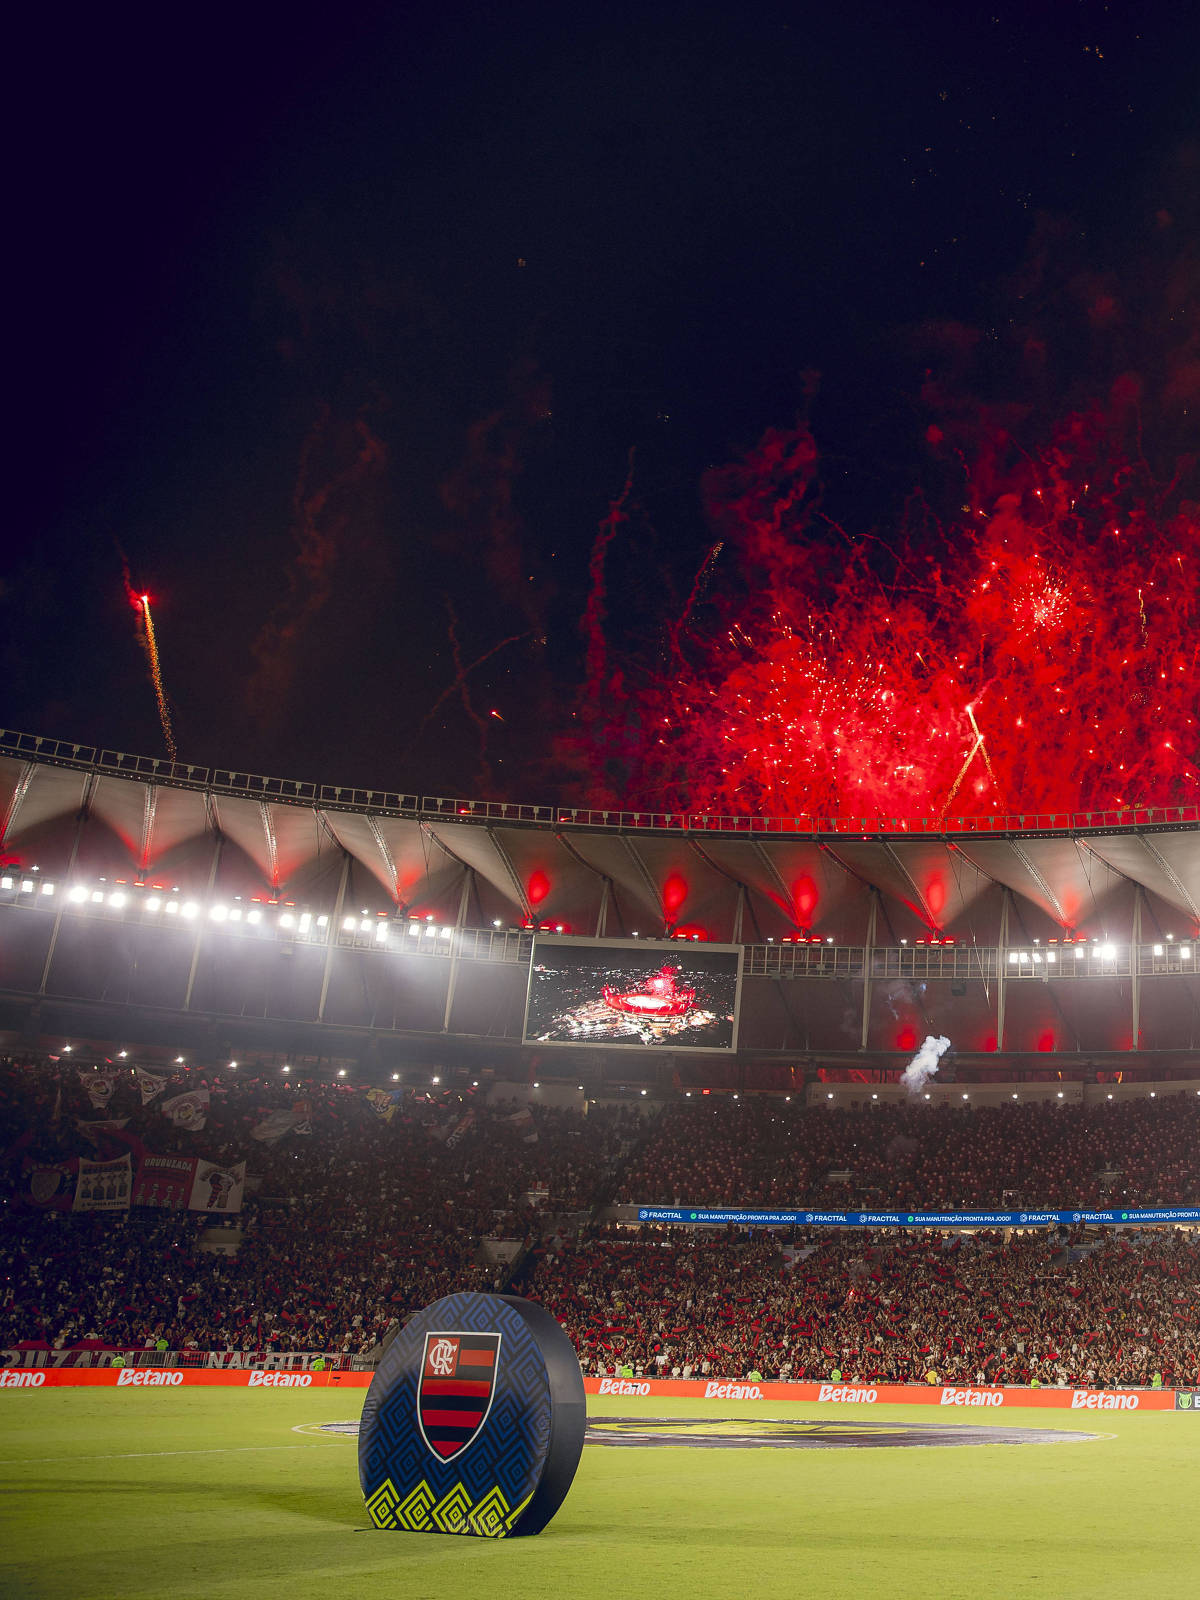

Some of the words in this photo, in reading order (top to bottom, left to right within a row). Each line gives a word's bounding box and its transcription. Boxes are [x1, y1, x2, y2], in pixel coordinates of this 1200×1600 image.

[649, 1211, 682, 1219] FRACTTAL
[711, 1213, 746, 1221] MANUTENÇÃO
[1140, 1211, 1176, 1219] MANUTENÇÃO
[0, 1370, 45, 1387] tano
[117, 1368, 183, 1386] Betano
[248, 1370, 312, 1387] Betano
[598, 1379, 650, 1396] Betano
[704, 1382, 760, 1399] Betano
[818, 1385, 877, 1403] Betano
[940, 1388, 1004, 1406] Betano
[1071, 1391, 1139, 1409] Betano
